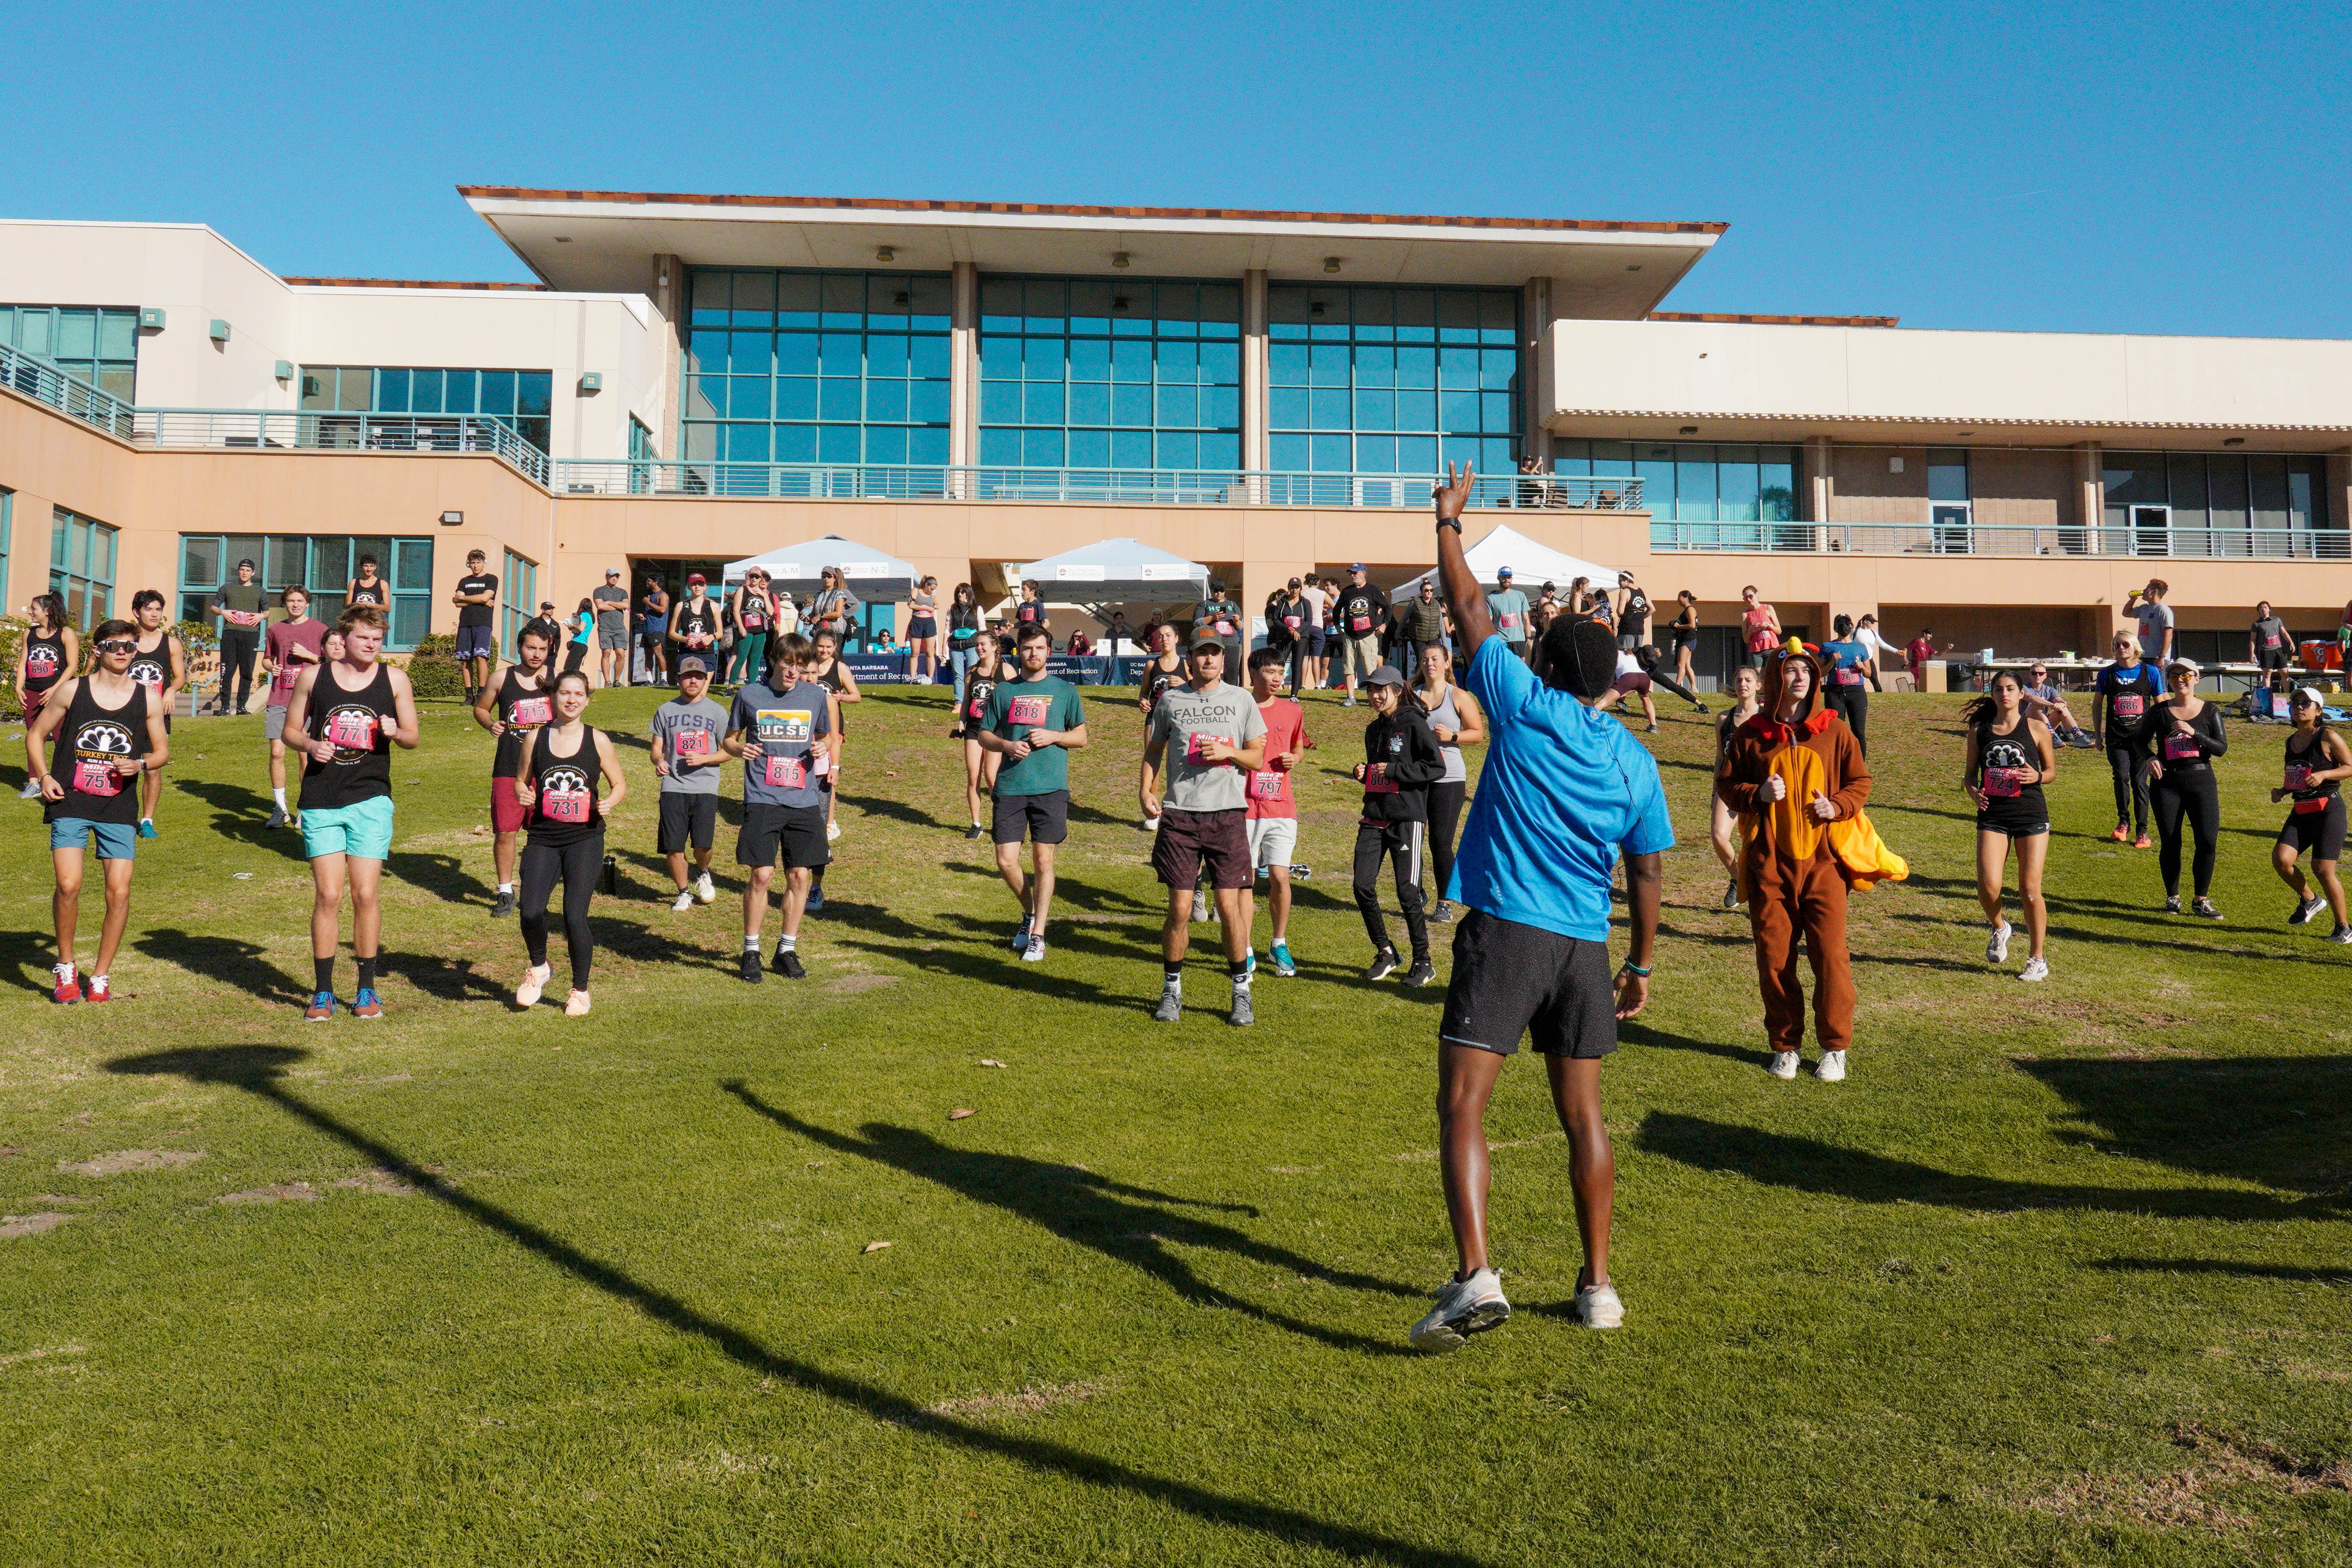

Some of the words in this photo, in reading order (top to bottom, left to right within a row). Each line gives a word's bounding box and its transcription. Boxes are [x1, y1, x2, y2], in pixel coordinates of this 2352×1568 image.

[522, 706, 545, 718] 715
[1014, 705, 1039, 719] 818
[2120, 701, 2138, 710] 686
[1174, 705, 1236, 720] FALCON
[668, 714, 715, 732] UCSB
[1181, 717, 1230, 725] FOOTBALL
[339, 727, 368, 742] 771
[760, 725, 808, 735] UCSB
[682, 738, 702, 750] 821
[76, 750, 107, 759] TURKEY
[773, 766, 799, 781] 815
[84, 773, 113, 789] 751
[1257, 781, 1282, 794] 797
[1989, 777, 2014, 790] 724
[551, 800, 579, 815] 731
